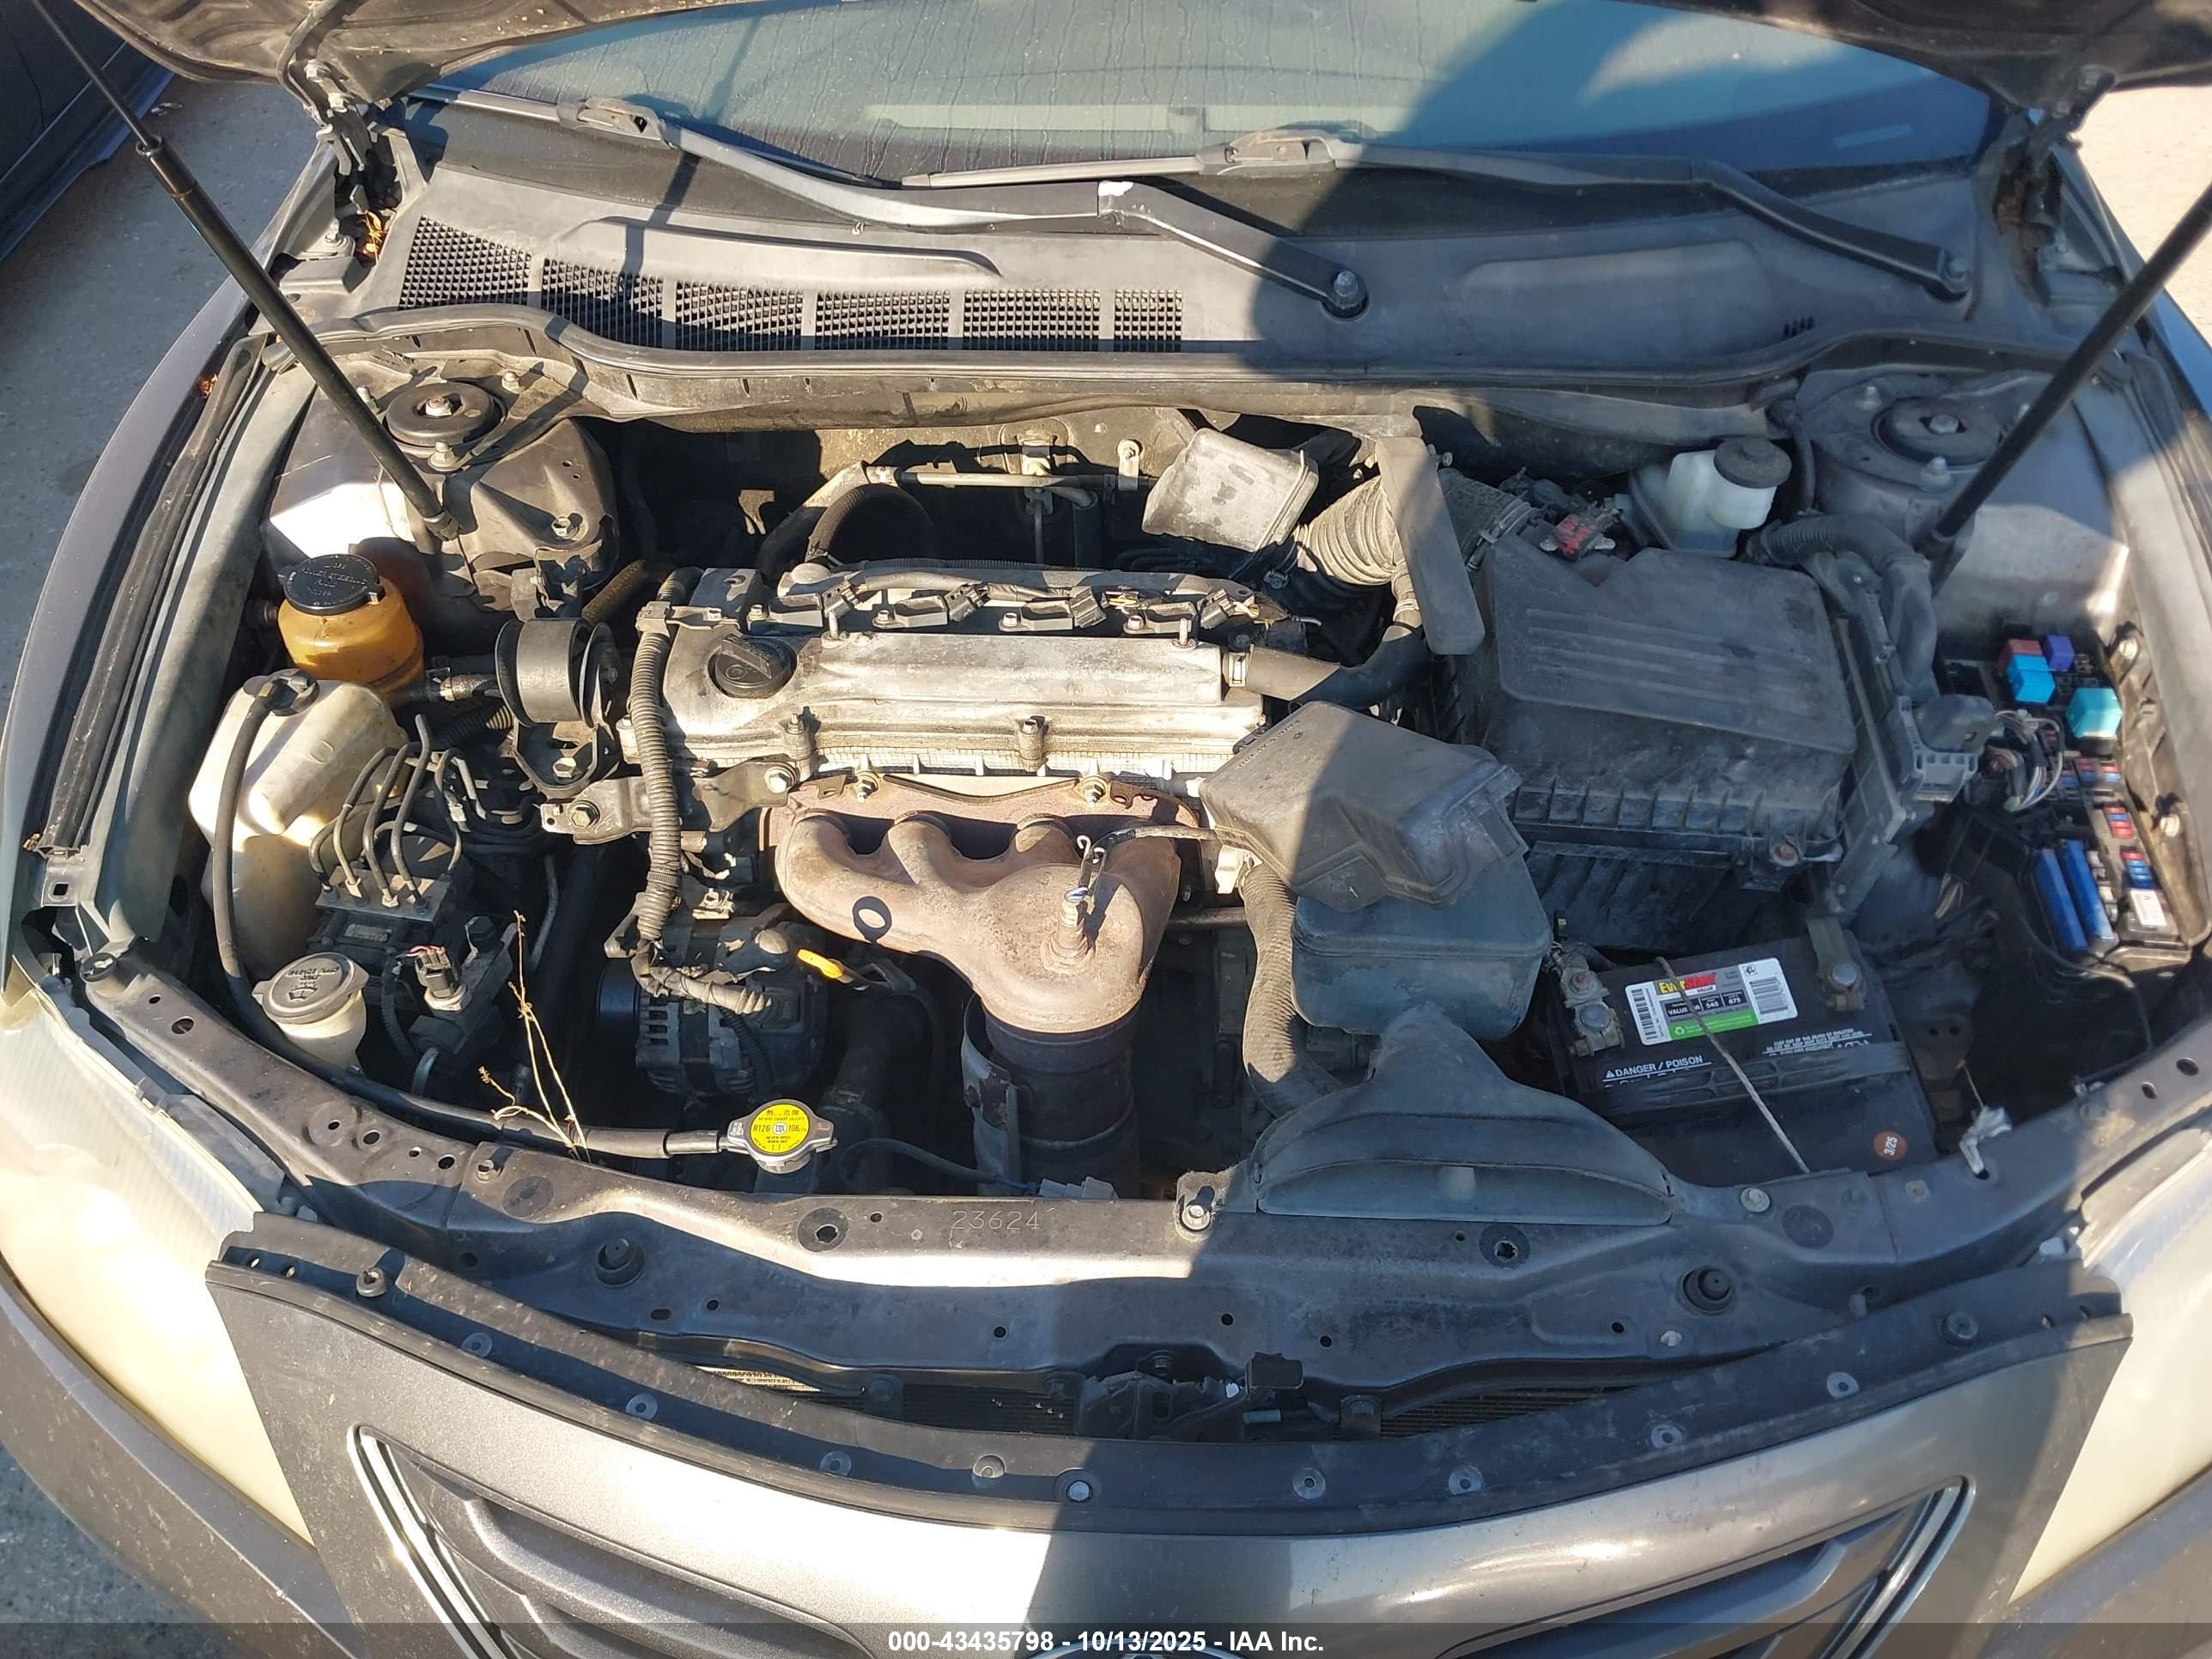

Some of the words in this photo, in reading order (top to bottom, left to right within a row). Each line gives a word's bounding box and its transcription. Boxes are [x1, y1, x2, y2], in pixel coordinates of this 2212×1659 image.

[1705, 1000, 1720, 1010] 540
[1615, 1063, 1656, 1077] DANGER
[1666, 1055, 1704, 1068] POISON
[1883, 1136, 1898, 1156] 3/25
[951, 1210, 1040, 1231] 23624
